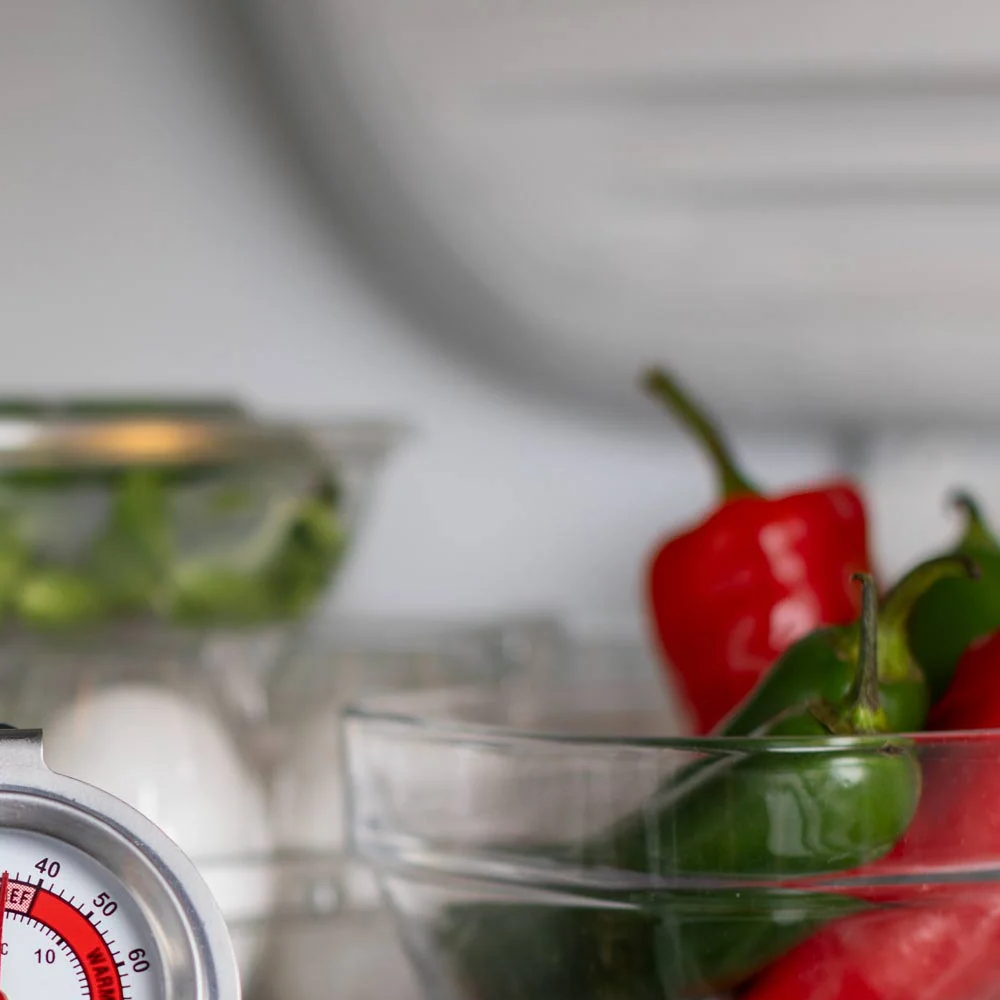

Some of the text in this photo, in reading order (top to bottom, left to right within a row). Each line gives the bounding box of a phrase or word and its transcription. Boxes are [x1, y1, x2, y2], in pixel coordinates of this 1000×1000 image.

[34, 857, 61, 878] 40
[93, 891, 118, 917] 50
[34, 948, 56, 964] 10
[128, 948, 150, 973] 60
